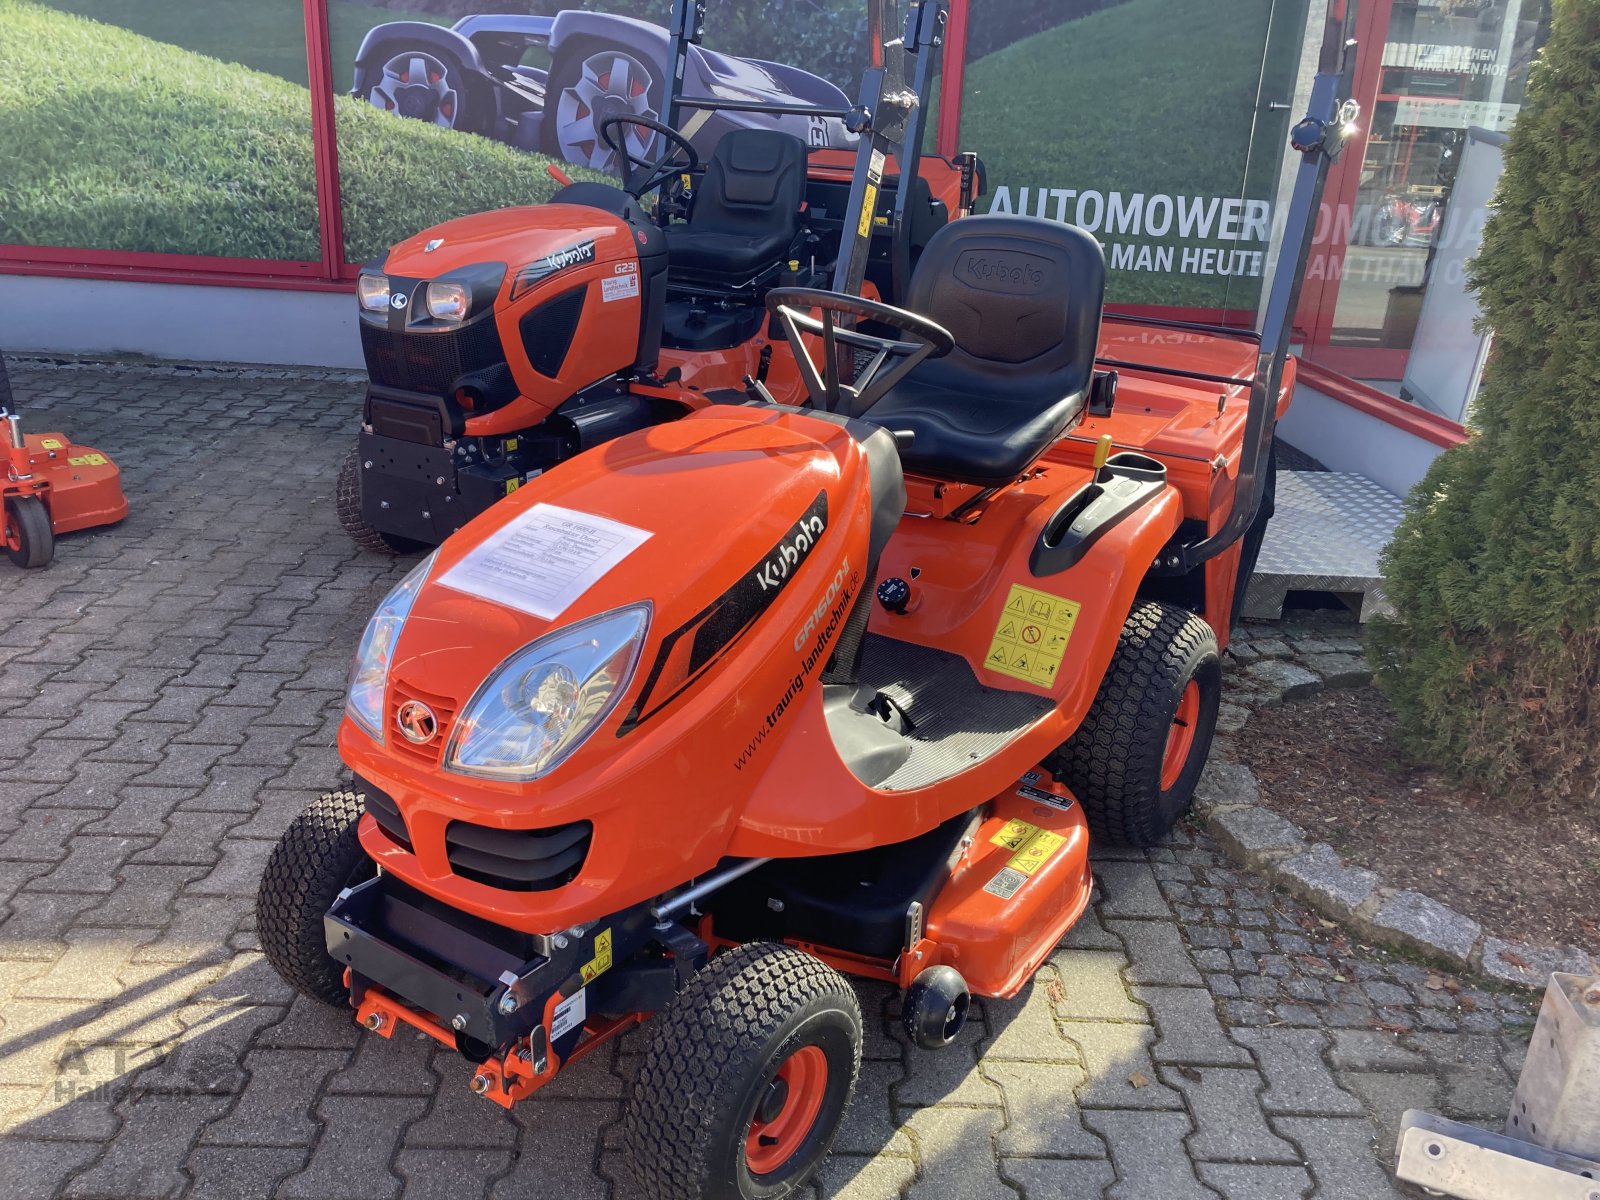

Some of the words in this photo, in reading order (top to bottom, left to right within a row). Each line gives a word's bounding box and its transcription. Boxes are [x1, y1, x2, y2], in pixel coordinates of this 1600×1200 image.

[988, 186, 1269, 241] AUTOMOWER
[547, 240, 595, 269] Kubota
[614, 262, 637, 274] G231
[1110, 243, 1174, 273] MAN
[1180, 247, 1262, 277] HEUTE
[968, 257, 1045, 287] Kubota
[756, 515, 825, 591] Kubota
[733, 570, 860, 772] www.traurig-landtechnik.de
